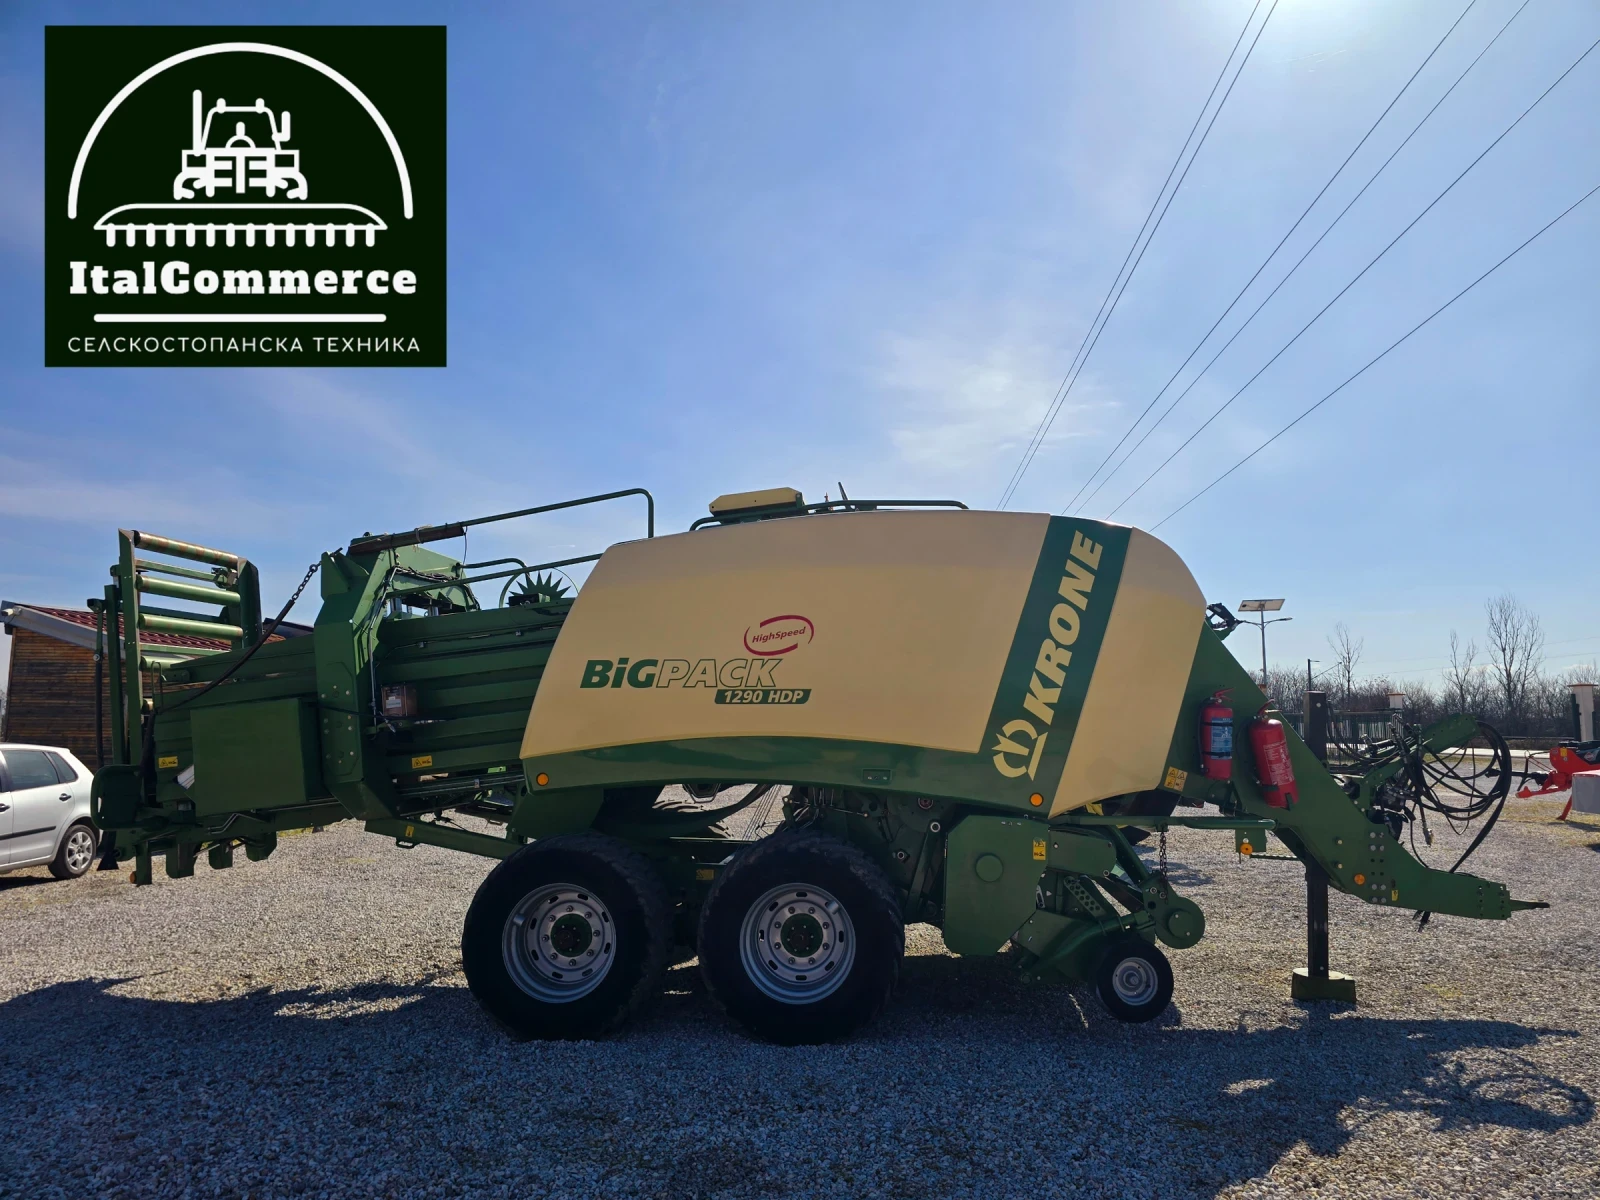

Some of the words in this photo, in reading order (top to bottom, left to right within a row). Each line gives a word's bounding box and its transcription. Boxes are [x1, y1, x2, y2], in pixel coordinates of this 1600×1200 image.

[752, 626, 806, 644] HighSpeed
[1023, 530, 1103, 726] KRONE
[580, 657, 783, 688] BiGPACK
[724, 690, 763, 703] 1290
[767, 690, 804, 703] HDP
